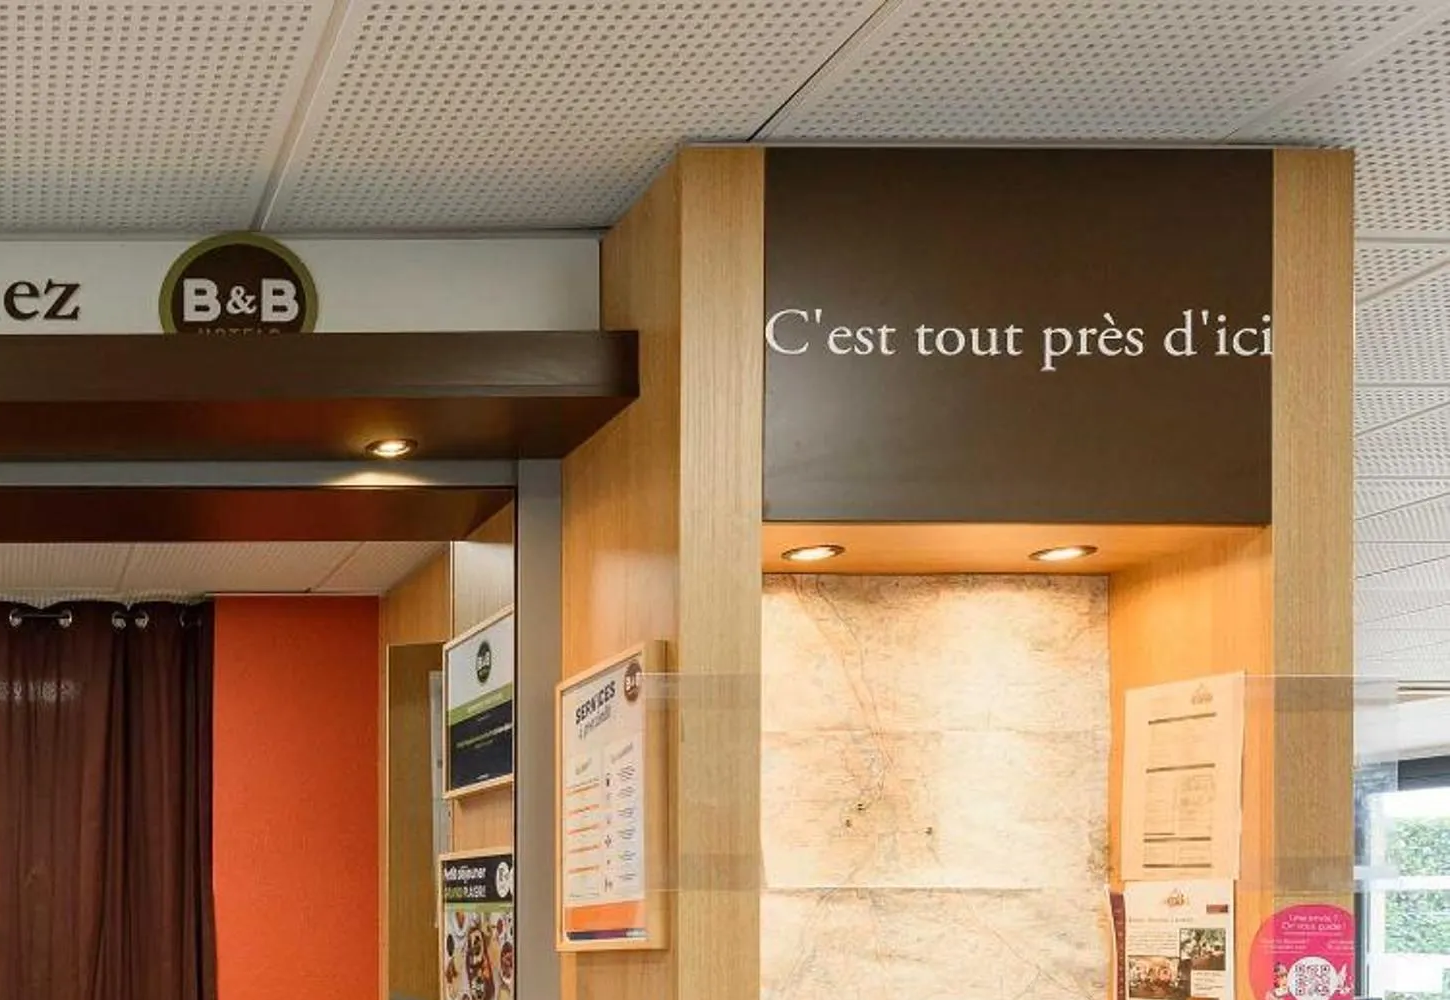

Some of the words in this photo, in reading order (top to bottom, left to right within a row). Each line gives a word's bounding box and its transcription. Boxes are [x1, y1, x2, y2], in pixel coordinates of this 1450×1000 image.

[183, 278, 299, 322] B&B
[765, 309, 896, 356] C'est
[915, 322, 1024, 356] tout
[1040, 313, 1145, 372] près
[1163, 309, 1272, 357] d'ici
[575, 680, 616, 725] SERVICES
